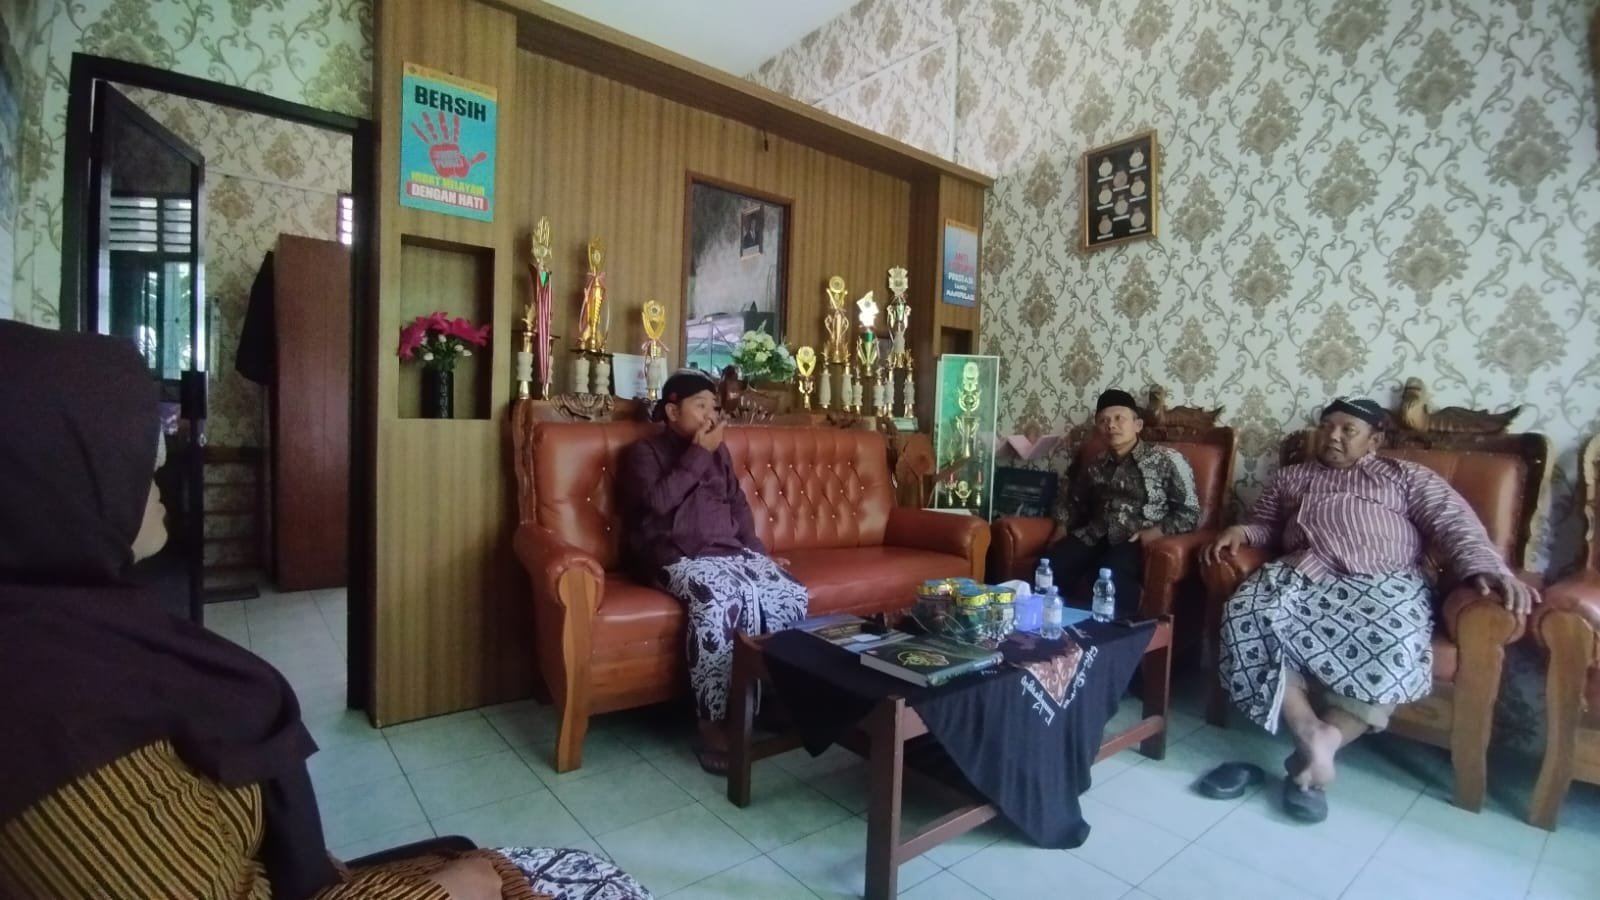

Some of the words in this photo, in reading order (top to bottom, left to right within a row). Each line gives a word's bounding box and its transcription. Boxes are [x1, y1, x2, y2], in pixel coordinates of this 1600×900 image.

[414, 85, 486, 122] BERSIH
[411, 183, 457, 203] DENGAN
[458, 193, 484, 210] HATI
